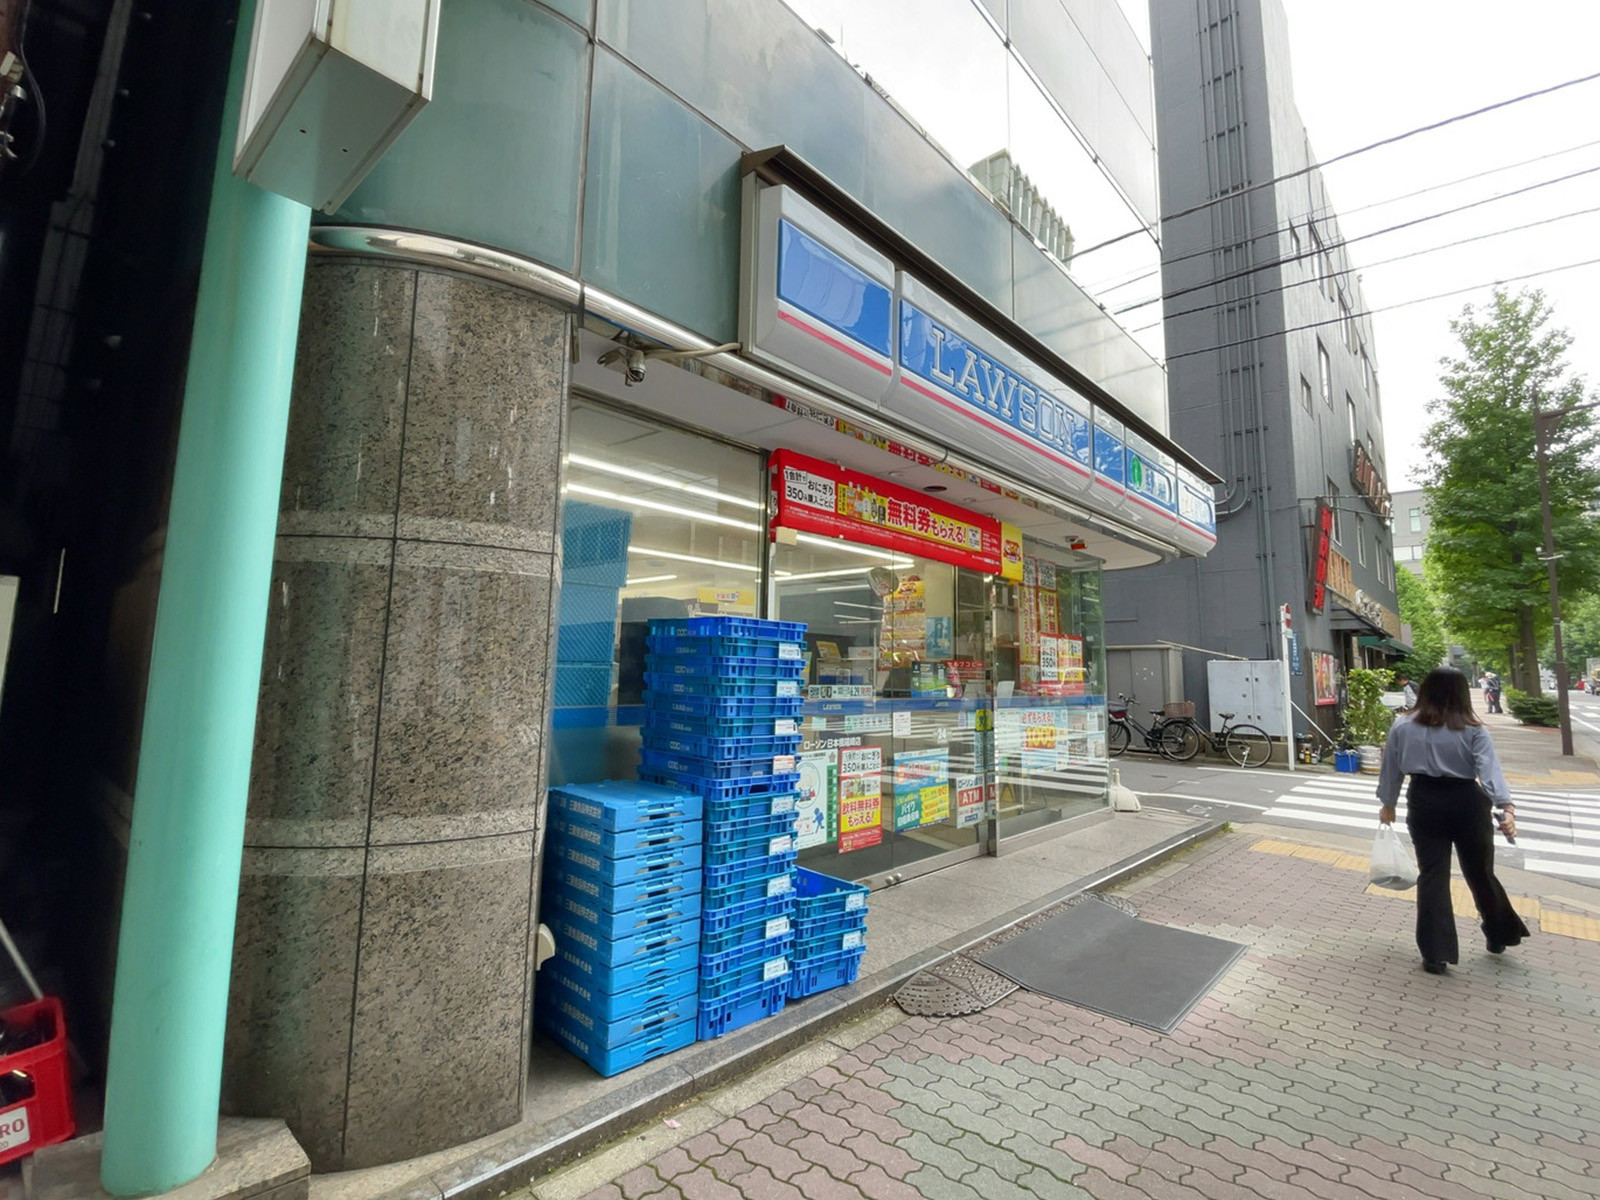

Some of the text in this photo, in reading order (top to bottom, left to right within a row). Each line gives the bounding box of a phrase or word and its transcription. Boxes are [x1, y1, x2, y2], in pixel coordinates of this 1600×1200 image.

[930, 325, 1075, 449] LAWSON
[807, 479, 834, 496] おにぎり
[962, 788, 981, 804] ATM
[842, 797, 879, 815] 飲料無料券
